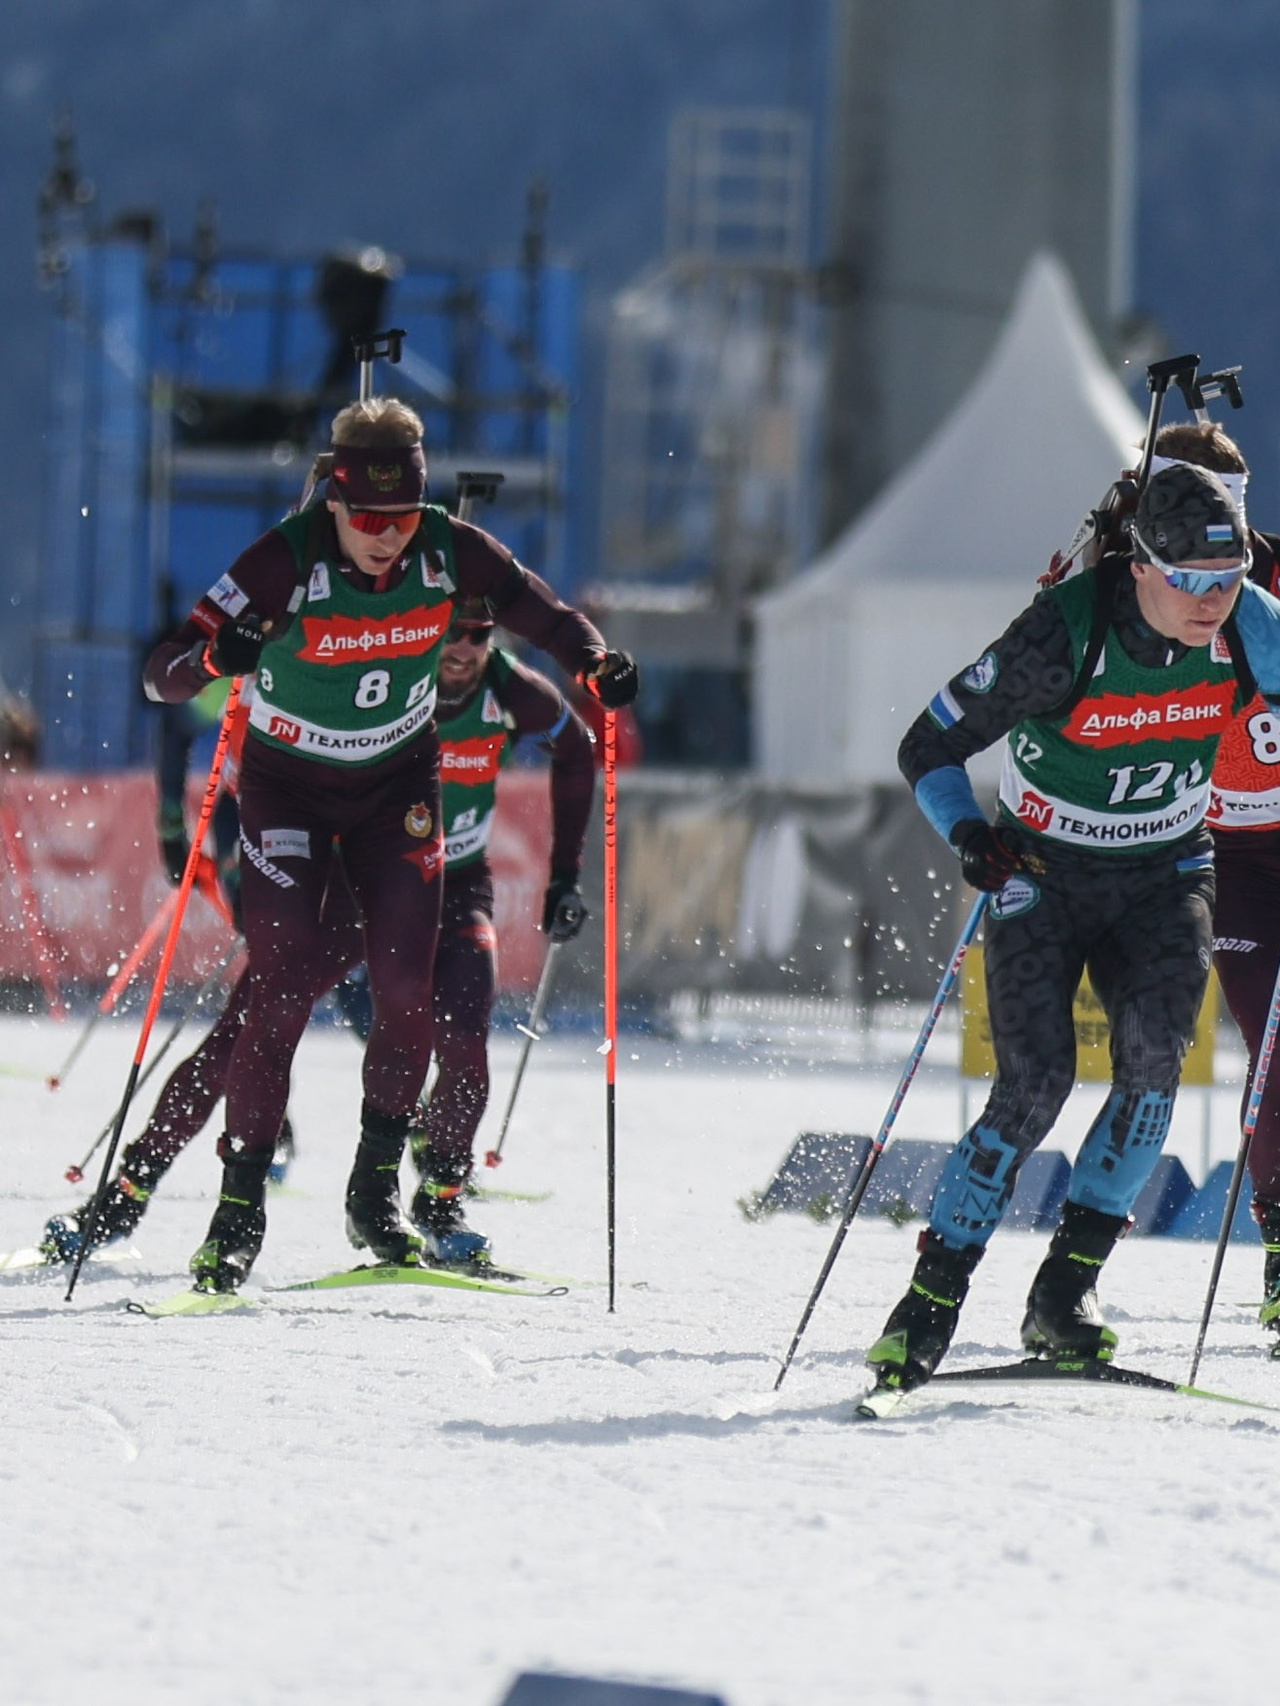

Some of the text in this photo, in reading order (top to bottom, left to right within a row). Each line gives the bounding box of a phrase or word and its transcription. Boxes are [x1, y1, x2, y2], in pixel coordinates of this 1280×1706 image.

[316, 623, 441, 657] Альфа Банк
[354, 669, 391, 709] 8
[1080, 703, 1223, 736] Альфа Банк
[441, 752, 491, 769] Банк
[1016, 732, 1043, 771] 12
[1107, 760, 1175, 806] 12
